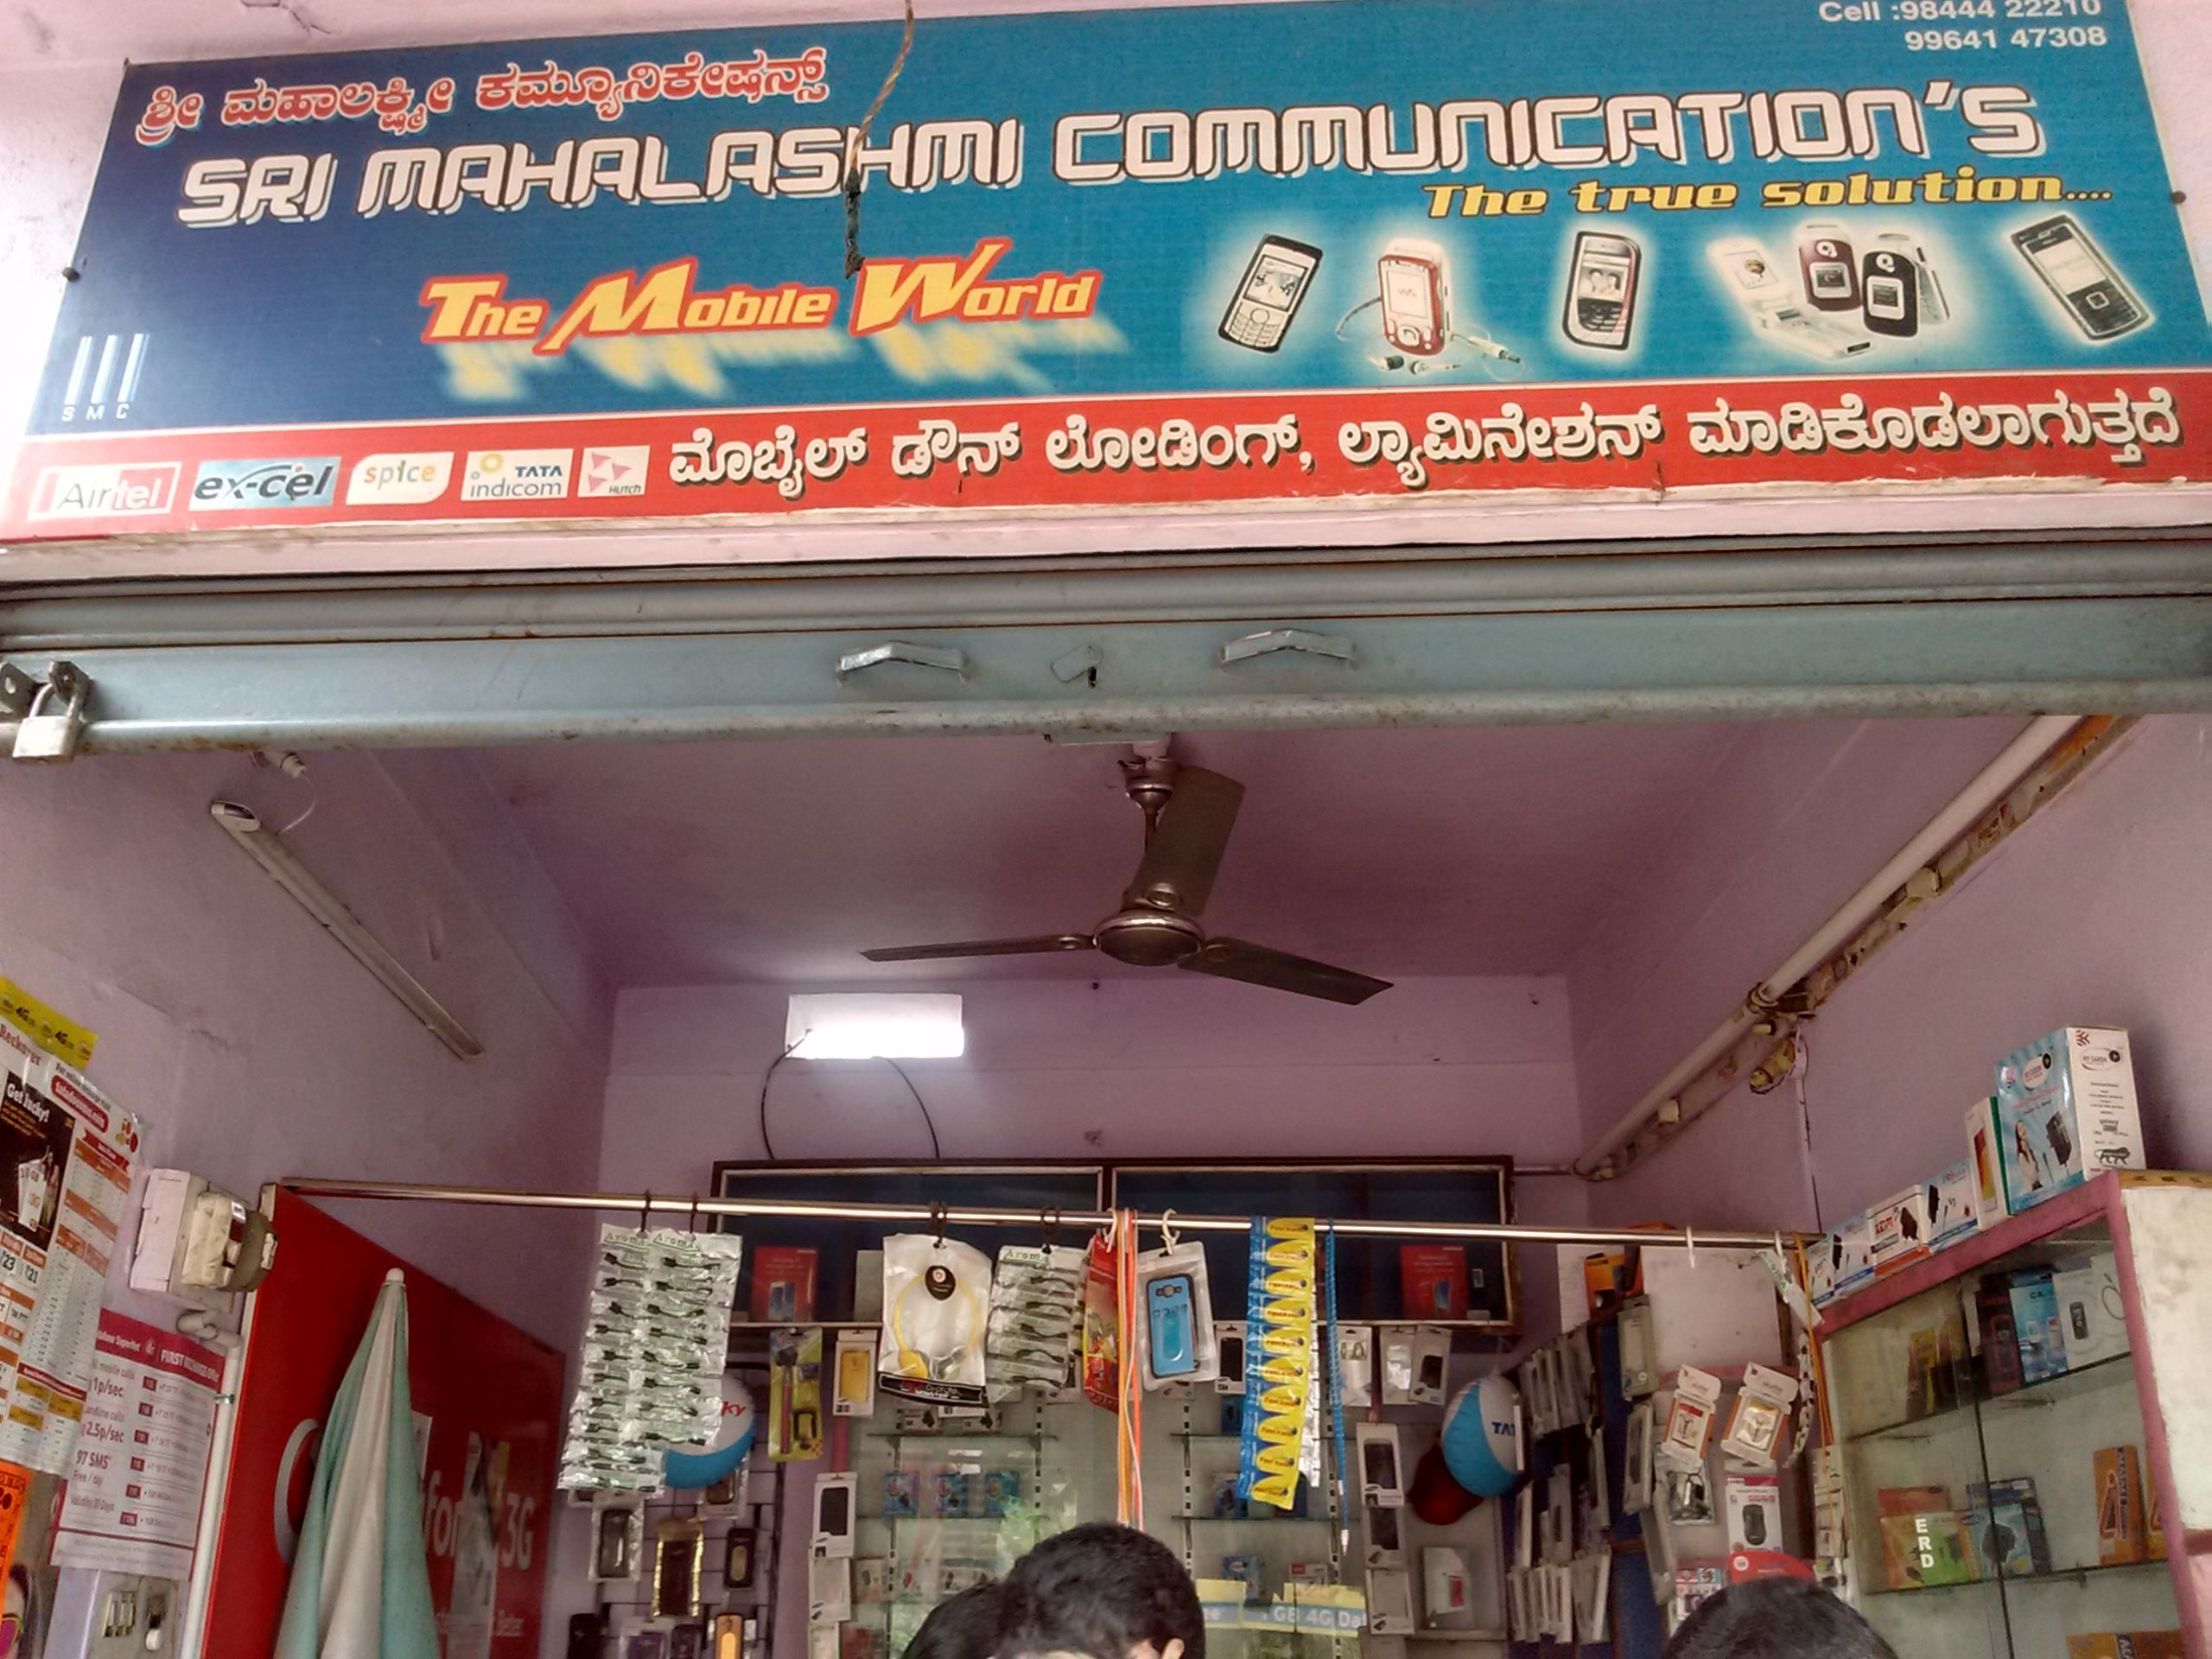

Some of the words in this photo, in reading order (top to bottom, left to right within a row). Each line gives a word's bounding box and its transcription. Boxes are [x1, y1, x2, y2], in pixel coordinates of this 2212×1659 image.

[1819, 0, 1881, 22] Cell
[1905, 29, 1998, 51] 99641
[2011, 26, 2107, 47] 47308
[136, 86, 204, 145] ಶ್ರೀ
[177, 153, 338, 226] SRI
[356, 118, 1023, 219] MAHALASHMI
[1053, 79, 2046, 185] COMMUNICATION'S
[1423, 183, 1548, 218] The
[1570, 180, 1738, 214] true
[420, 276, 550, 343] The
[532, 257, 840, 356] Mobile
[849, 237, 1103, 338] World
[670, 424, 867, 500] ಮೊಬೈಲ್
[891, 419, 1020, 476] ಡೌನ್
[1687, 387, 2183, 466] ಮಾಡಿಕೊಡಲಾಗುತ್ತದೆ
[364, 460, 435, 490] spice
[470, 478, 562, 498] indicom
[515, 466, 563, 478] TATA
[57, 477, 162, 510] Airtel
[7, 1083, 23, 1104] Get
[499, 1491, 536, 1571] 3G
[1915, 1518, 1935, 1569] ERD
[1306, 1608, 1334, 1626] 4G
